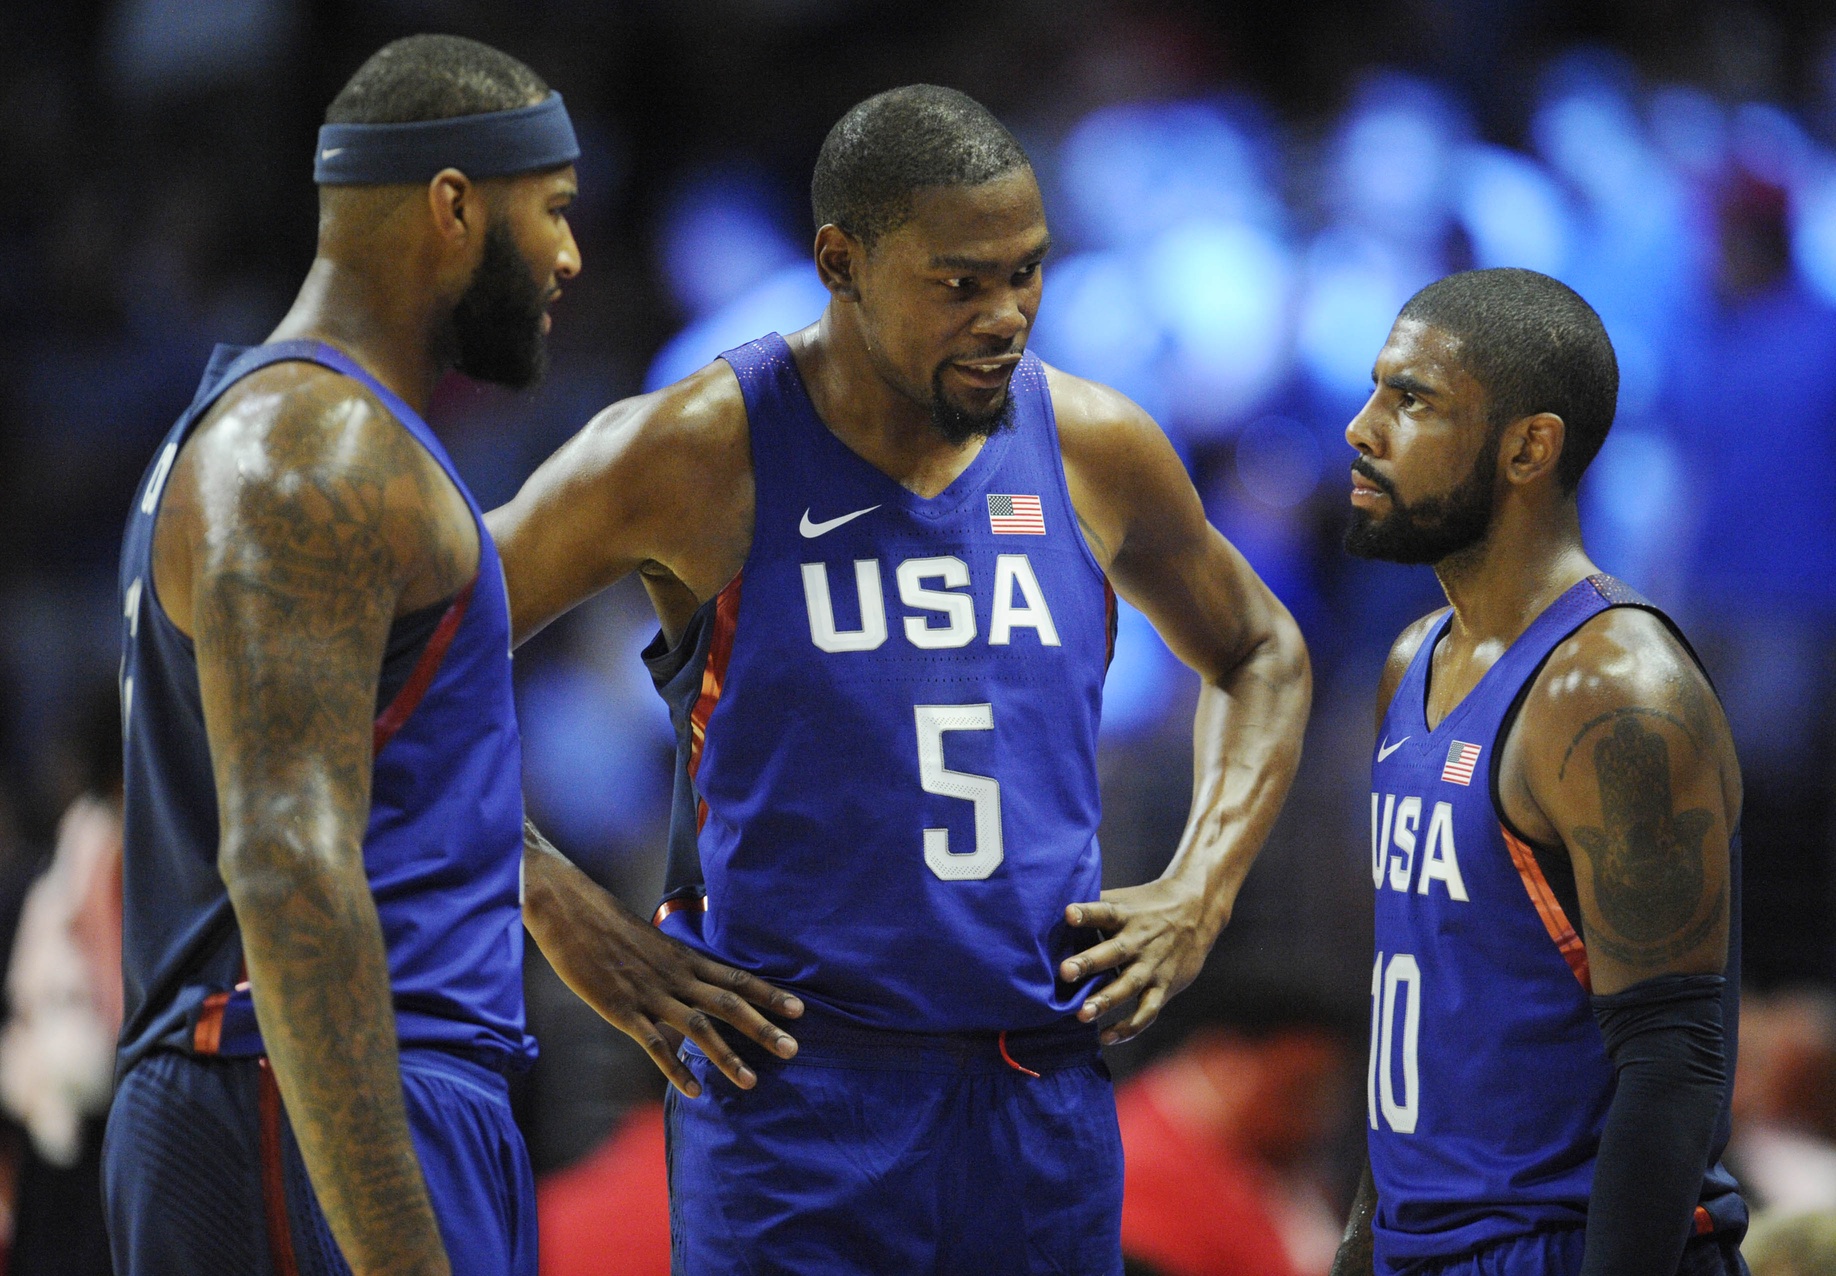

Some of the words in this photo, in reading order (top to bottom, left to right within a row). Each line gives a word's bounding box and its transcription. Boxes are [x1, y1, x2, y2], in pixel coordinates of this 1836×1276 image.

[800, 554, 1061, 653] USA
[914, 703, 1004, 880] 5
[1371, 792, 1470, 901] USA
[1367, 951, 1421, 1134] 10
